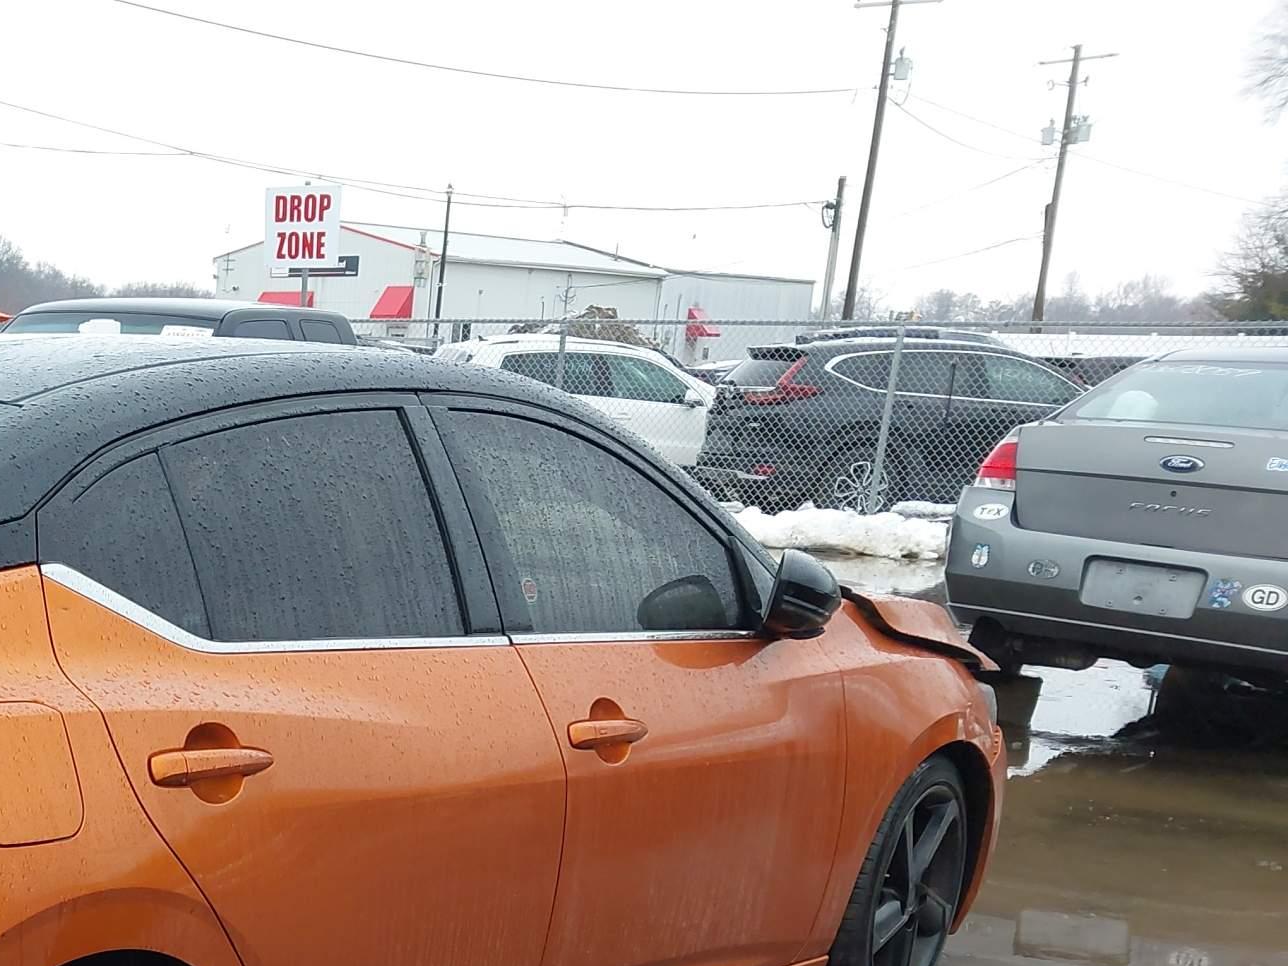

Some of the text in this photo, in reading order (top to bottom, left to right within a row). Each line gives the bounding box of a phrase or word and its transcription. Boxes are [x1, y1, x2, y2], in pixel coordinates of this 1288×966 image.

[274, 193, 332, 223] DROP
[276, 231, 326, 260] ZONE
[1251, 588, 1280, 606] GD
